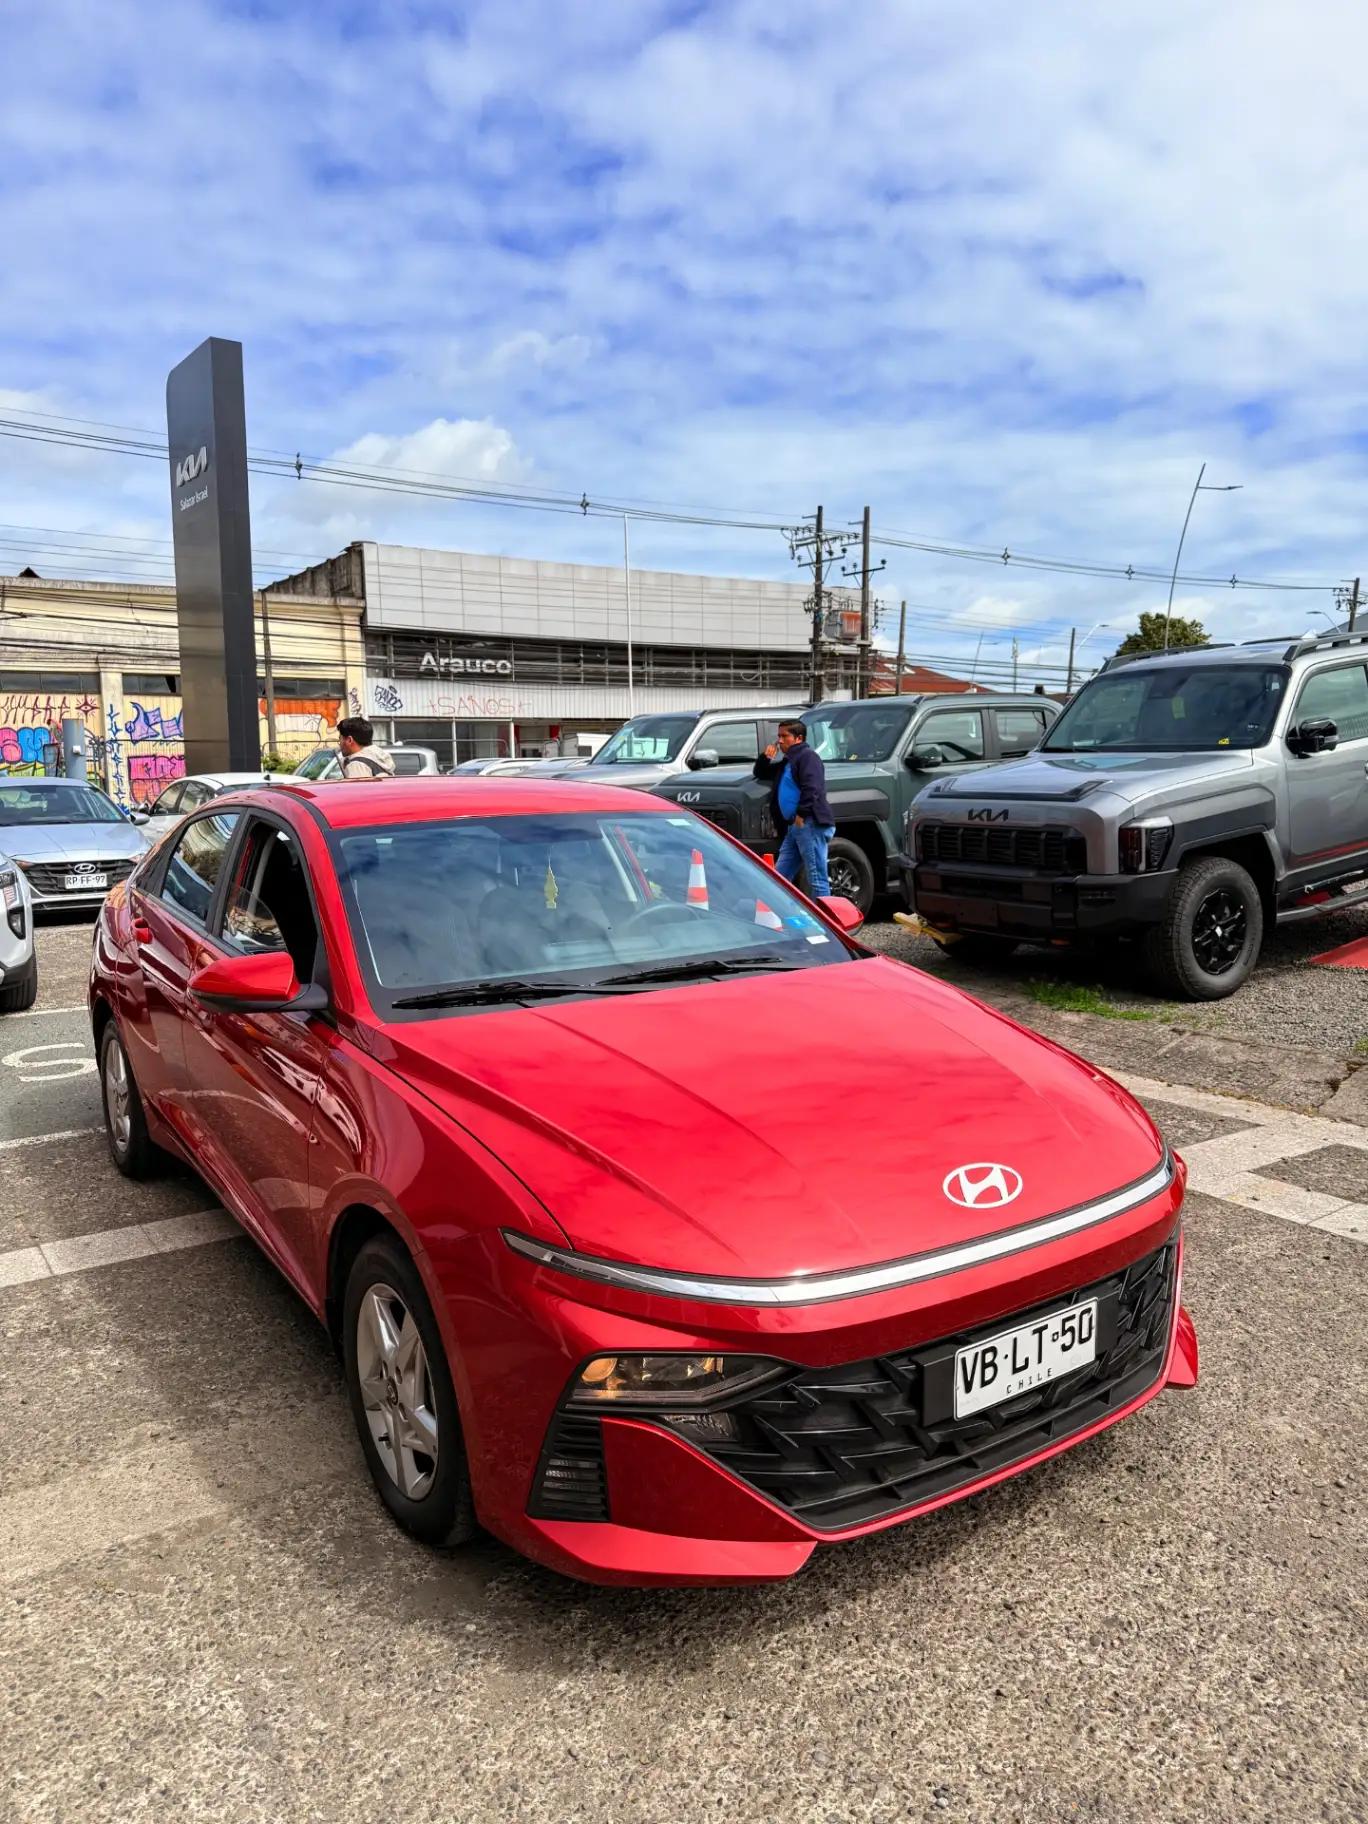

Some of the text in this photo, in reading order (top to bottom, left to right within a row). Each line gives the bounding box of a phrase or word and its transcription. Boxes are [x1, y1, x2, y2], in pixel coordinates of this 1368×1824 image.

[176, 446, 207, 488] KIA
[419, 652, 511, 674] Arauco
[677, 791, 700, 802] KIA
[968, 808, 1009, 821] KIA
[1006, 1368, 1053, 1394] CHILE
